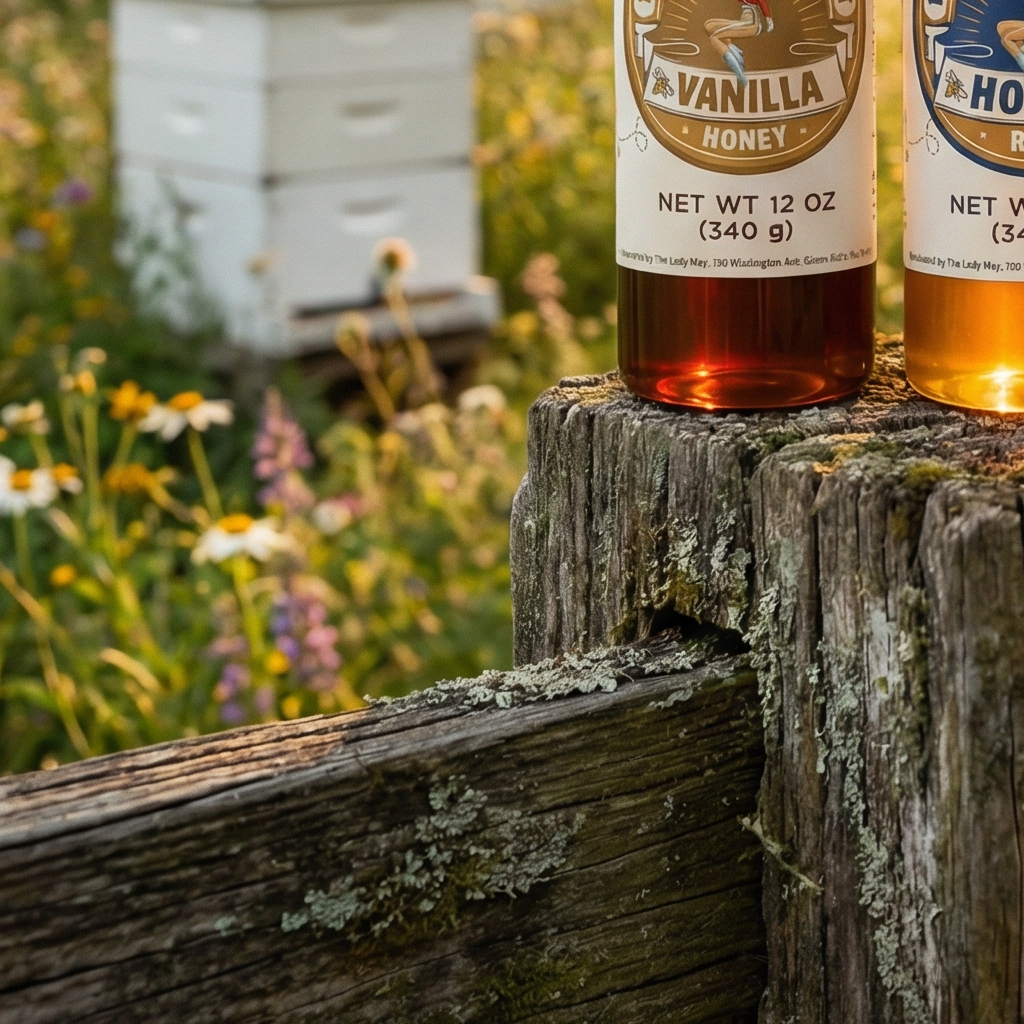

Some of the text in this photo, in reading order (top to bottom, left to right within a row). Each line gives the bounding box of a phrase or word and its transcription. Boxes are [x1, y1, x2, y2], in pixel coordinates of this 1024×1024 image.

[677, 70, 824, 113] VANILLA
[702, 125, 787, 151] HONEY
[659, 191, 836, 214] NET WT 12 OZ
[950, 195, 997, 215] NET
[699, 220, 793, 243] (340 g)
